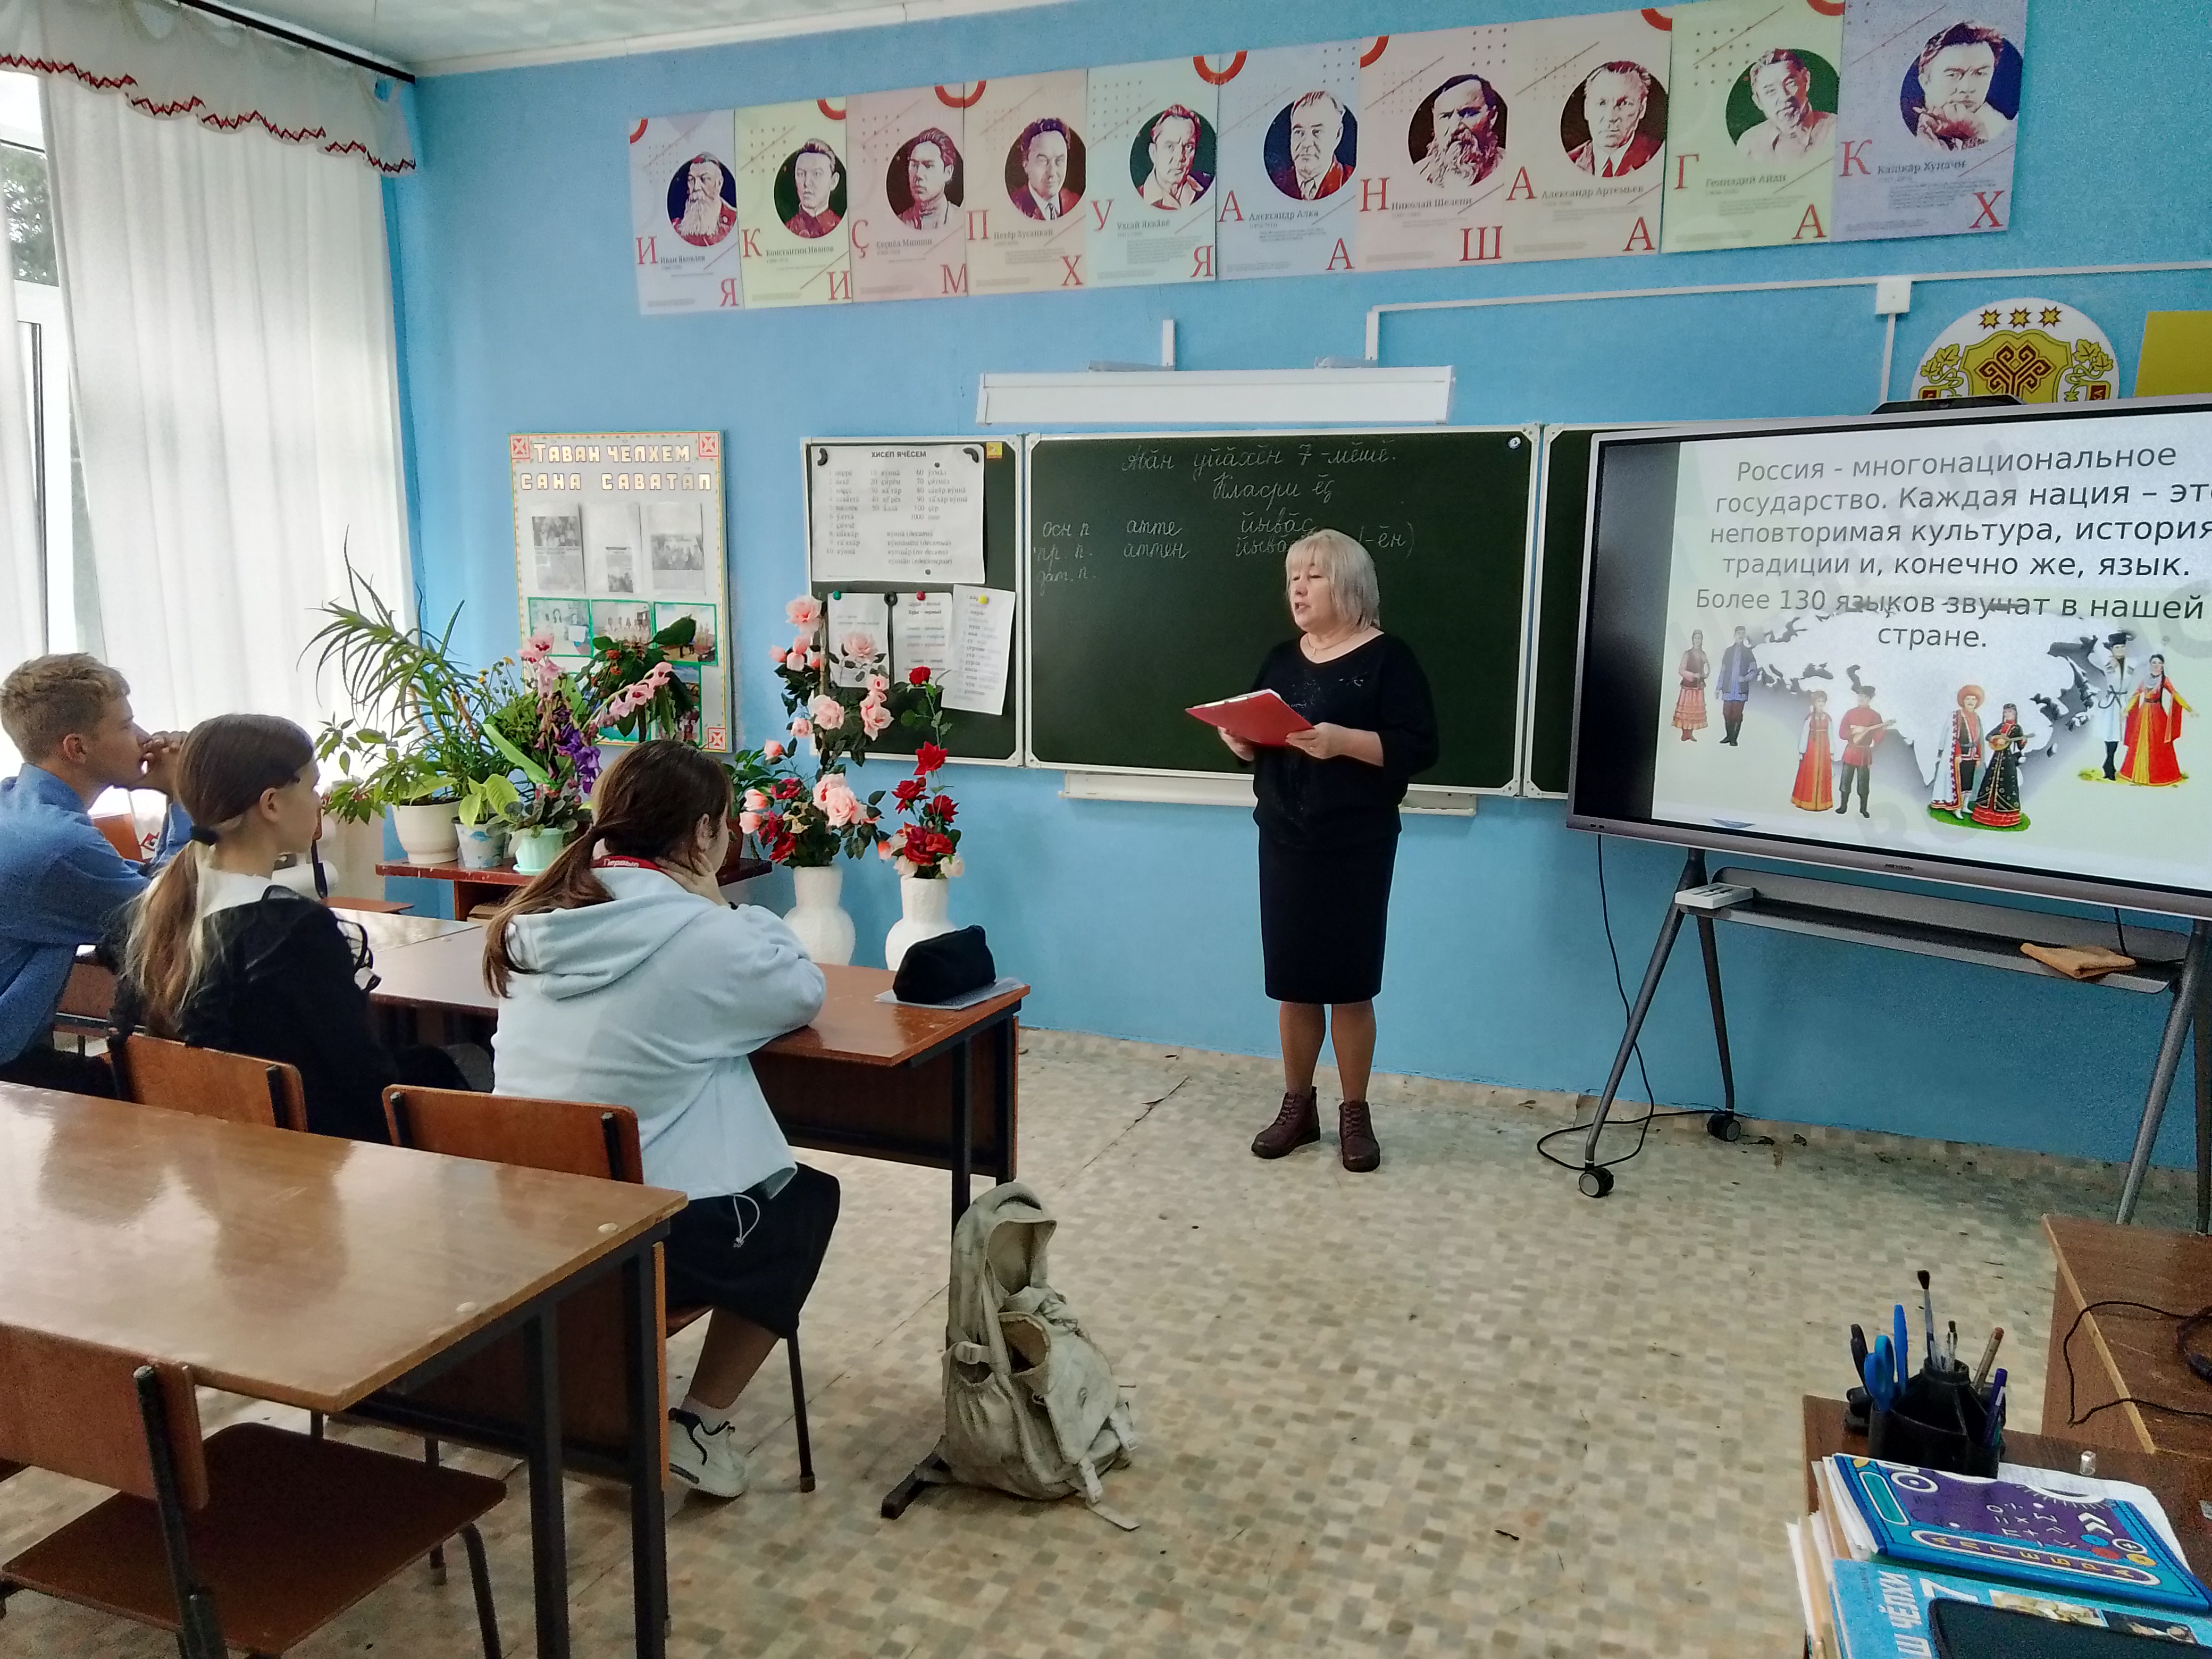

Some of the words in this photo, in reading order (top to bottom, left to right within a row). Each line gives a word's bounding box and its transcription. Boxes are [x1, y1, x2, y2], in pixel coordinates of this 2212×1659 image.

[1673, 153, 1699, 190] Г
[1839, 139, 1872, 177] К
[1360, 177, 1390, 212] Н
[1505, 166, 1537, 201] А
[1541, 189, 1593, 199] Александр
[1596, 186, 1644, 197] Артемьев
[1091, 198, 1115, 232] У
[1217, 190, 1245, 222] А
[1249, 212, 1295, 221] Александр
[1296, 210, 1319, 219] Алка
[1392, 199, 1432, 211] Николай
[1969, 190, 2005, 229] Х
[966, 210, 990, 240] П
[1018, 229, 1053, 239] Хусанкай
[1117, 219, 1141, 230] Ухсай
[1622, 216, 1655, 252] А
[1792, 204, 1827, 240] А
[635, 236, 658, 265] И
[741, 228, 763, 258] К
[766, 248, 807, 257] Константин
[1325, 238, 1355, 271] А
[1459, 225, 1503, 262] Ш
[678, 255, 706, 264] Яковлев
[1060, 254, 1084, 286] Х
[1190, 245, 1214, 278] Я
[719, 278, 740, 307] Я
[827, 270, 852, 300] И
[941, 263, 968, 294] М
[1738, 460, 1824, 481] Россия
[1853, 446, 2176, 477] многонациональное
[521, 473, 581, 490] САНА
[1716, 492, 1887, 517] государство.
[1899, 487, 2017, 510] Каждая
[2029, 485, 2129, 508] нация
[1126, 520, 1183, 537] атте
[1710, 523, 1901, 547] неповторимая
[1911, 522, 2062, 547] культура,
[1124, 542, 1190, 559] аттен
[1722, 557, 1849, 579] традиции
[1860, 557, 1882, 576] и,
[1894, 556, 2018, 575] конечно
[2029, 556, 2084, 579] же,
[2098, 557, 2190, 576] язык.
[1696, 589, 1770, 609] Более
[1780, 589, 1825, 610] 130
[1836, 595, 1935, 613] языков
[1945, 596, 2050, 620] звучат
[2061, 598, 2077, 616] в
[2090, 594, 2204, 619] нашей
[1878, 627, 1987, 650] стране.
[1930, 1536, 2136, 1579] АЛГЕБРА
